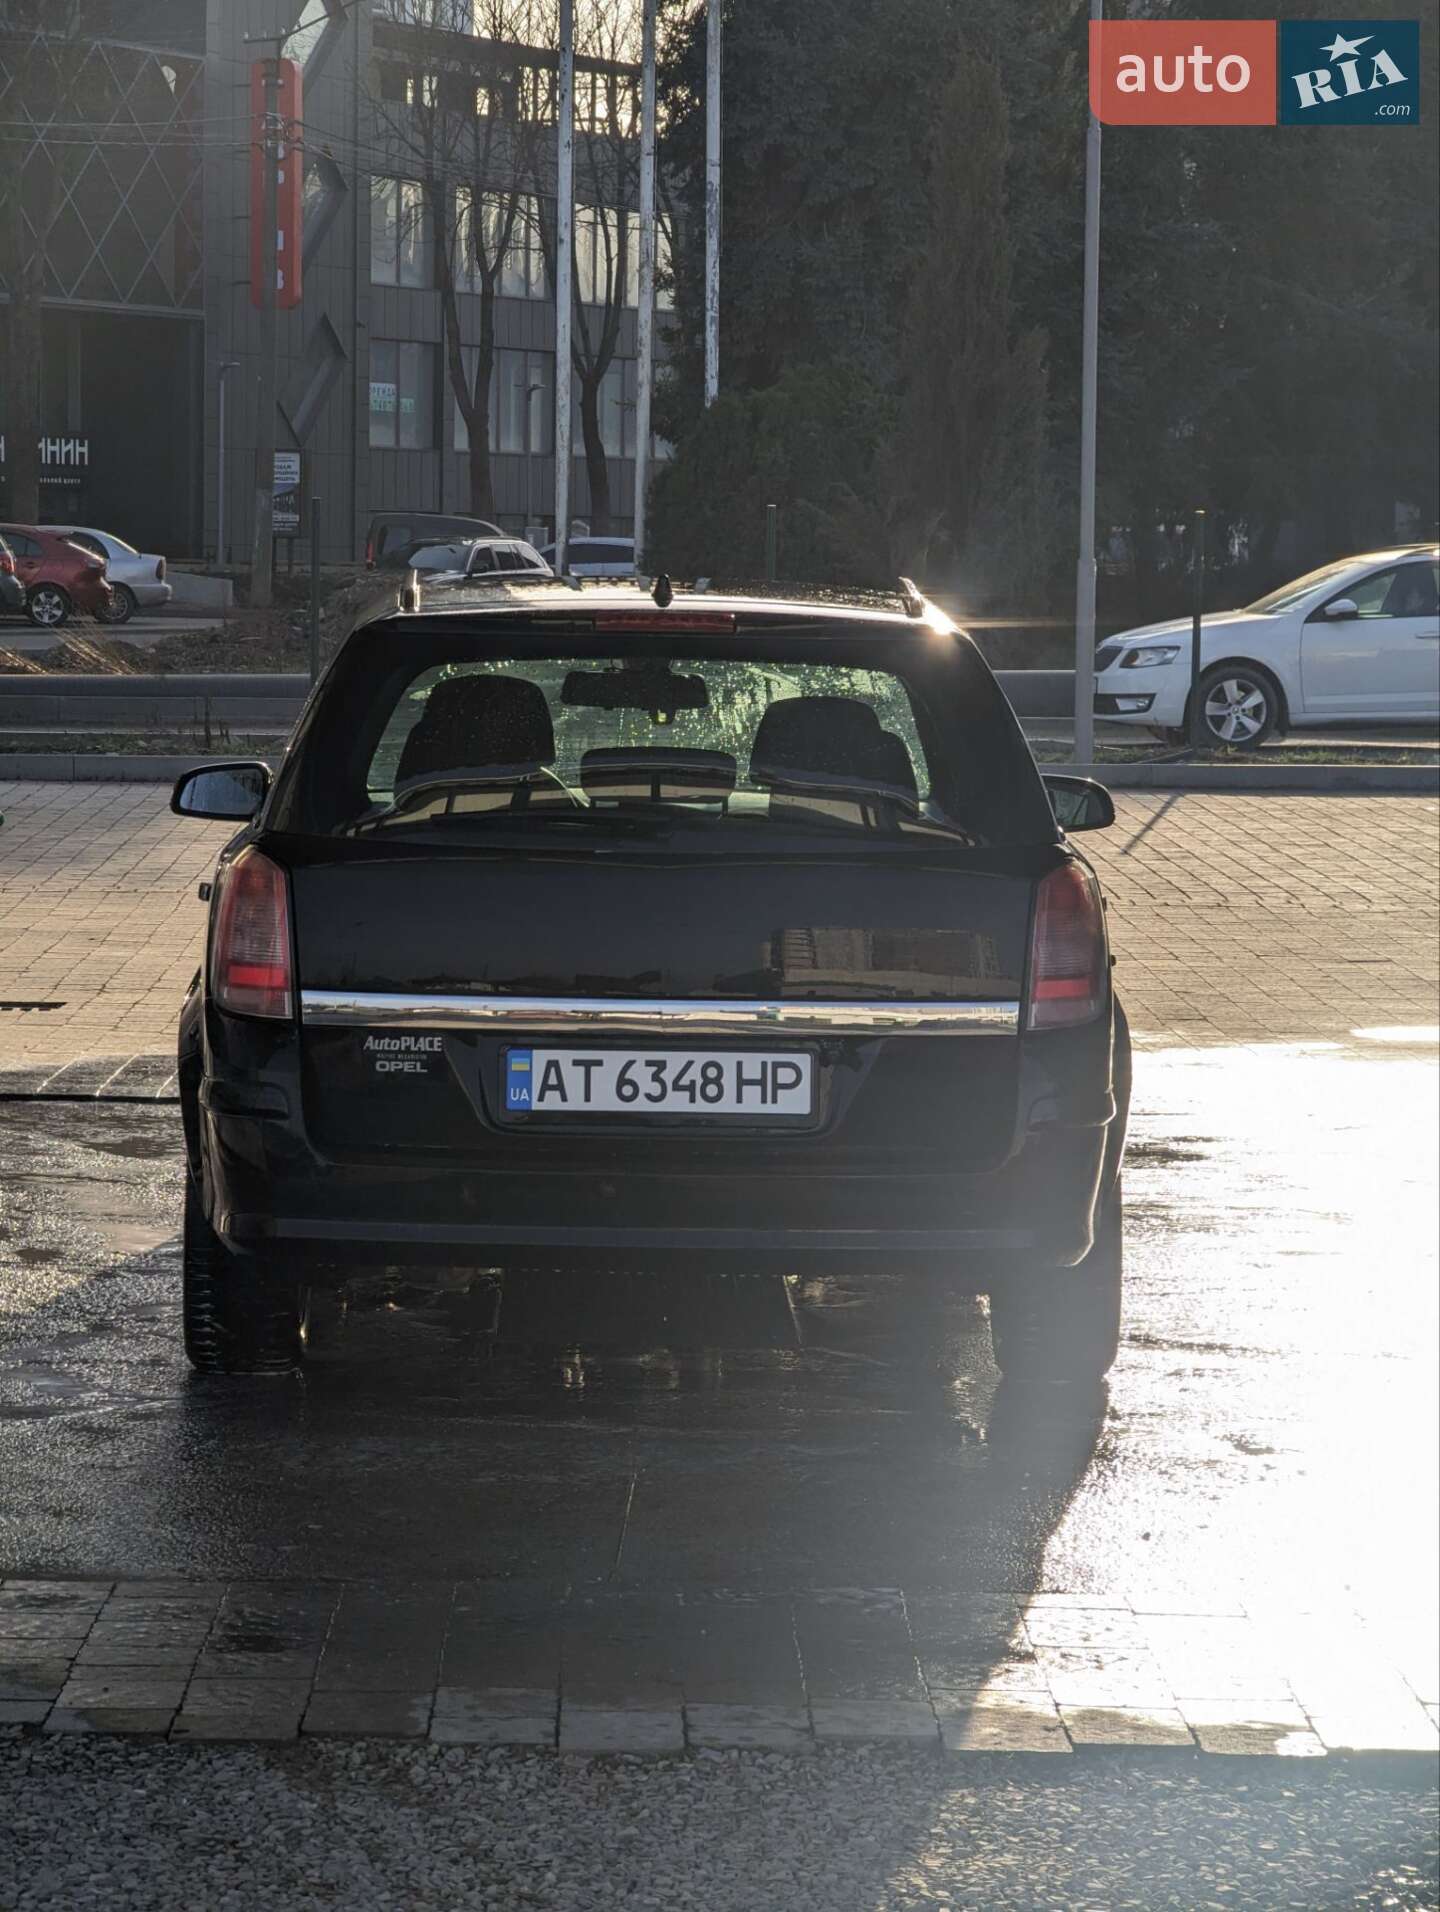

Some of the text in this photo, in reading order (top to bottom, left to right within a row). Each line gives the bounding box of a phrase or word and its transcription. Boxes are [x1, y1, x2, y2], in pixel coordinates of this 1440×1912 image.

[363, 1035, 443, 1052] AutoPLACE
[375, 1060, 428, 1073] OPEL
[537, 1059, 803, 1105] AT 6348 HP
[510, 1087, 530, 1101] UA
